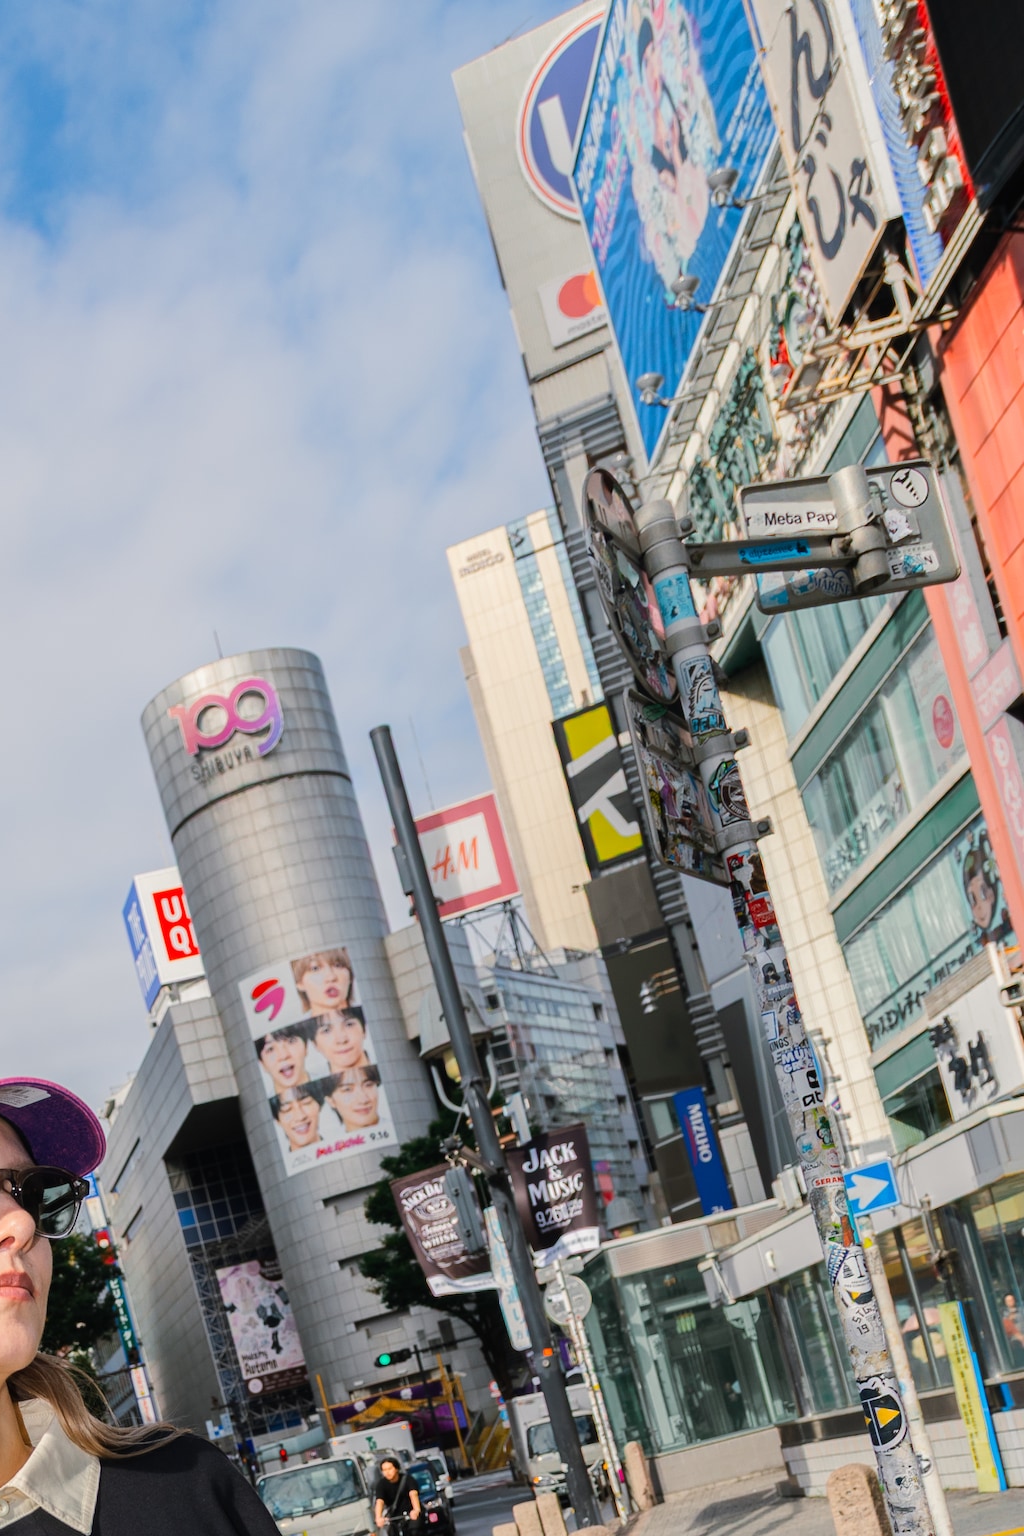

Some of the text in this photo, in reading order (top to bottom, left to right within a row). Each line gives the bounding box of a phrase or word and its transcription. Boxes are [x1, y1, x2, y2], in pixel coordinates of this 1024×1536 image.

[764, 511, 802, 526] Meta
[169, 676, 284, 757] 109
[191, 746, 253, 782] SHIBUYA
[432, 836, 479, 883] H&M
[686, 1103, 714, 1165] MIZUHO
[522, 1142, 578, 1174] JACK
[548, 1165, 563, 1181] &
[528, 1174, 584, 1206] MUSIC
